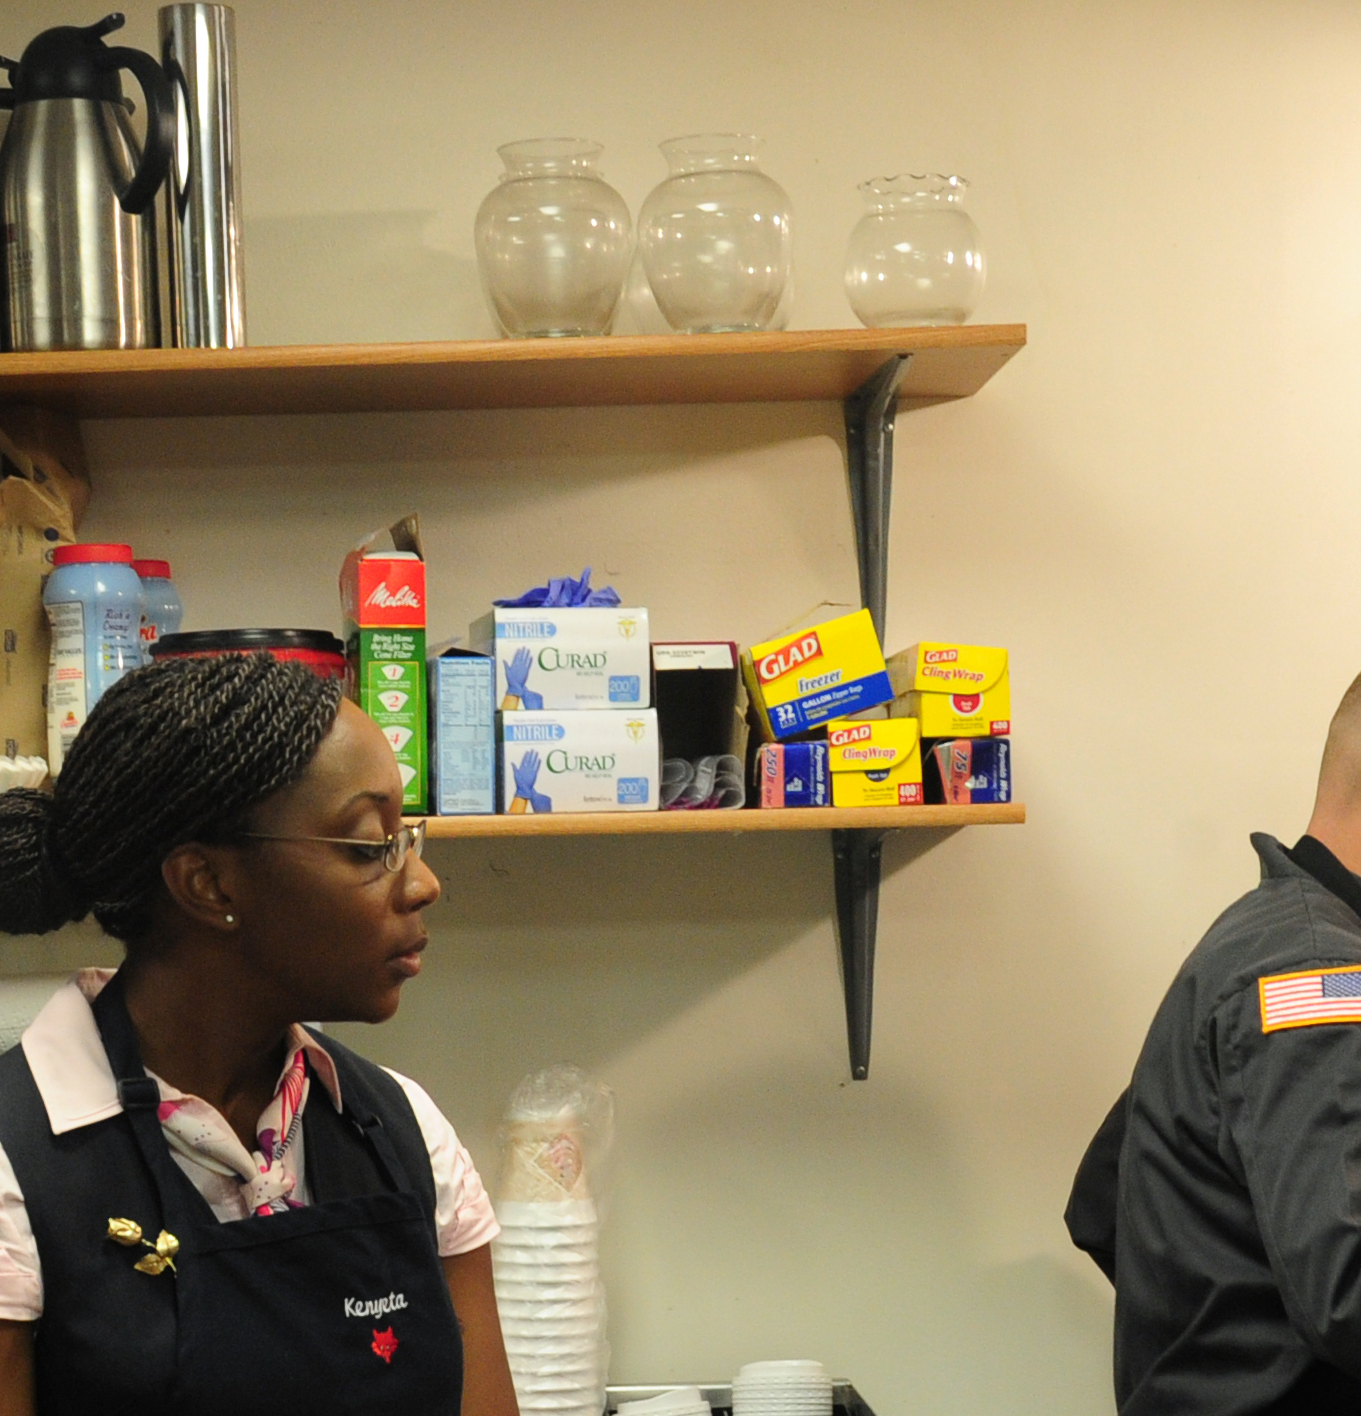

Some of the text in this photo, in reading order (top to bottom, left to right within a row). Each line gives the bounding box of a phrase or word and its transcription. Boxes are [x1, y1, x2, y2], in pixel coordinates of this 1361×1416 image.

[505, 623, 551, 638] NITRILE
[538, 647, 607, 671] CURAD
[759, 637, 818, 680] GLAD
[926, 651, 957, 662] GLAD
[776, 705, 795, 722] 32
[513, 726, 559, 741] NITRILE
[831, 727, 870, 745] GLAD
[546, 750, 616, 773] CURAD
[344, 1291, 408, 1319] Kenyeta
